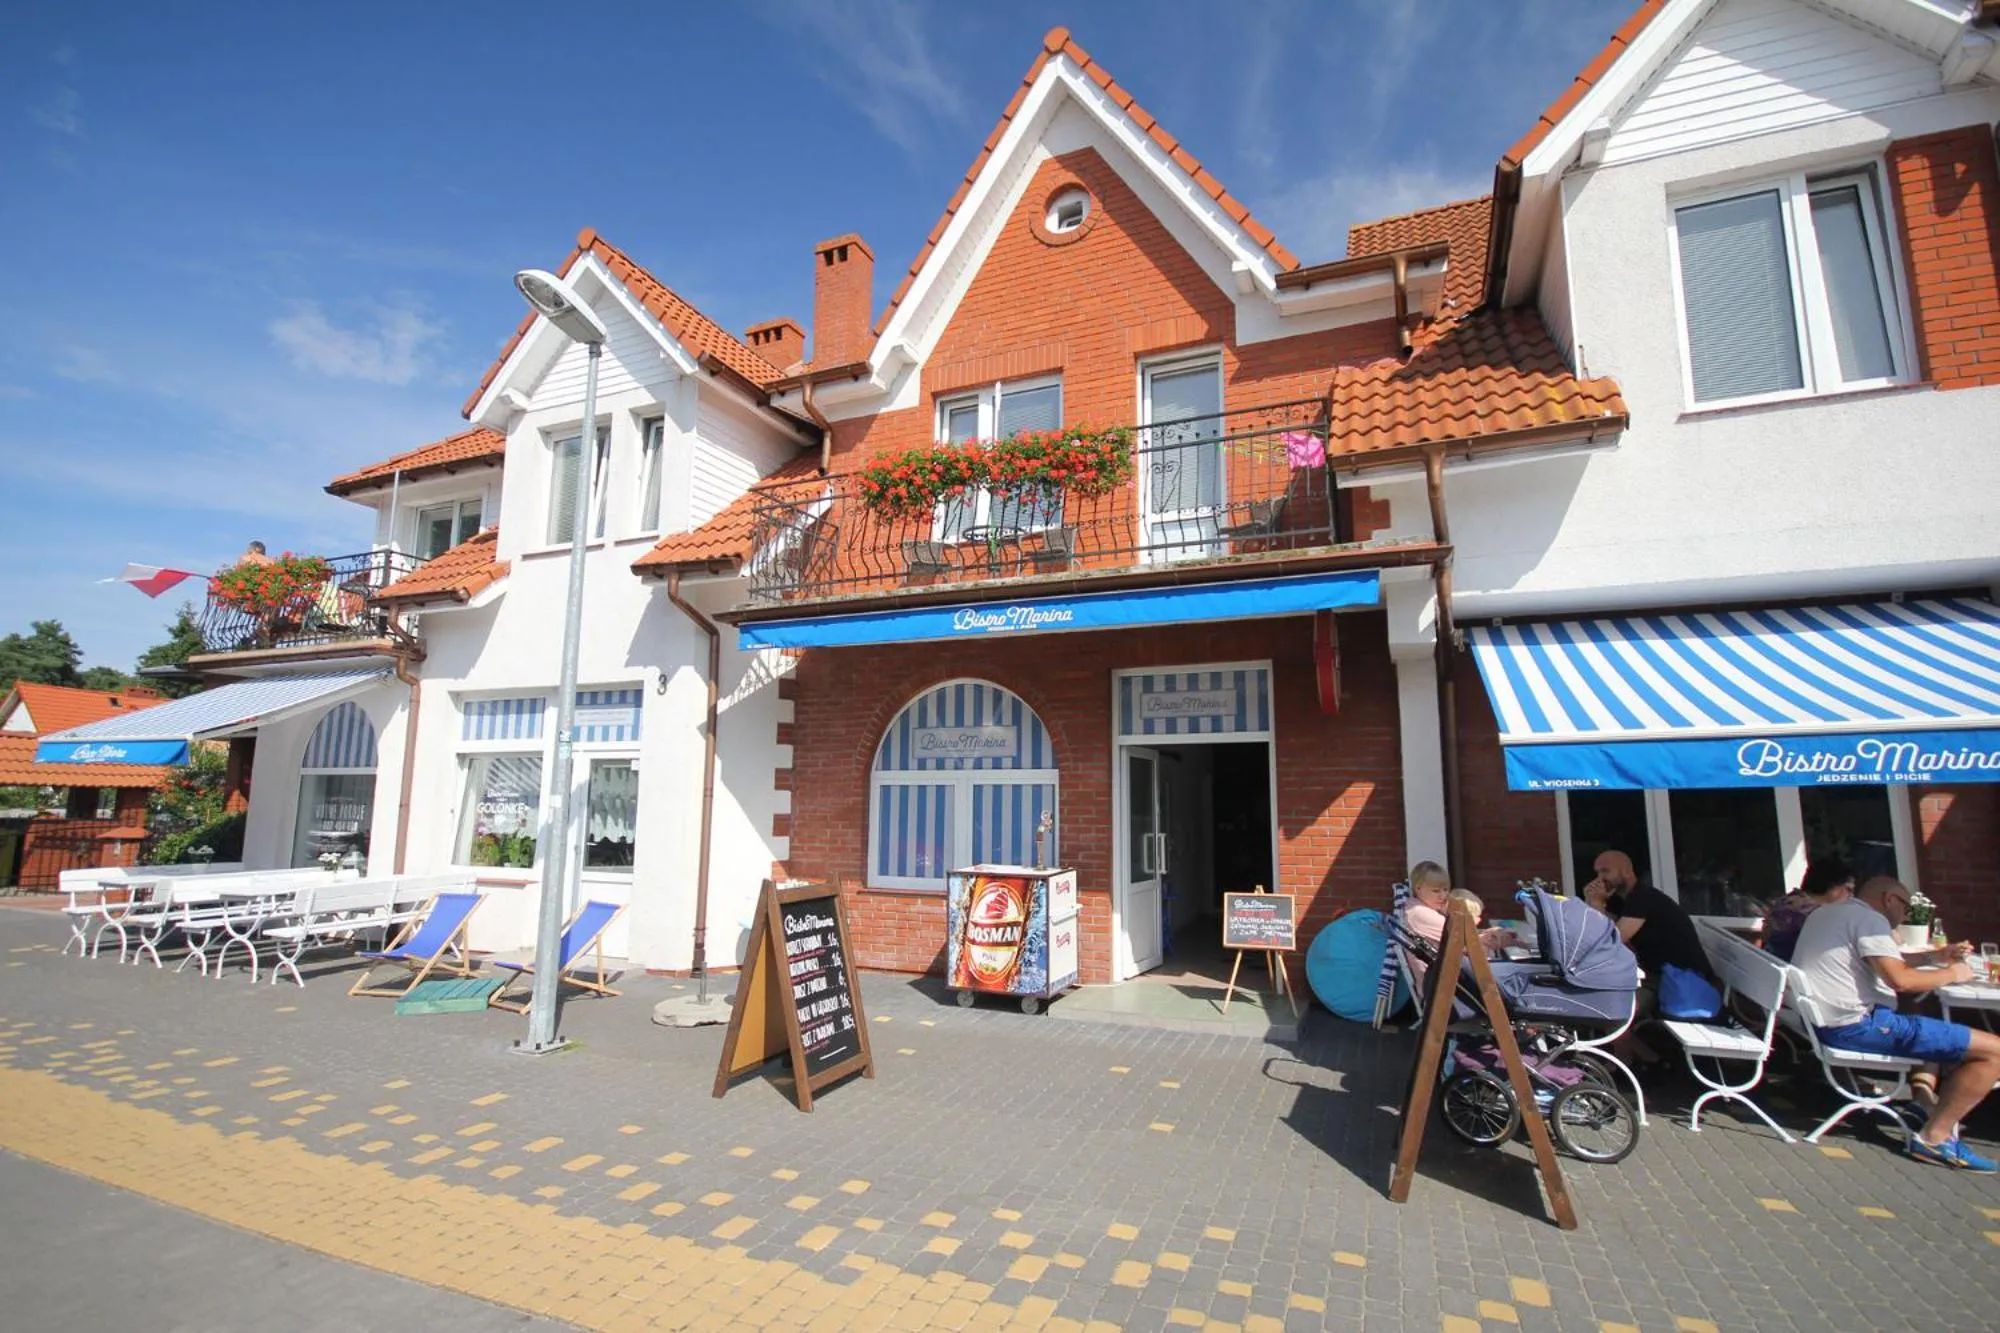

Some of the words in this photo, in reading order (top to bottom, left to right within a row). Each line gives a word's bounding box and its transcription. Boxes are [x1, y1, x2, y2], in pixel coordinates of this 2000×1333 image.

[953, 608, 1007, 630] Bistro
[1006, 606, 1073, 624] Marina
[657, 674, 668, 695] 3
[920, 733, 960, 751] Bistro
[958, 734, 1006, 749] Marina
[1737, 738, 1857, 777] Bistro
[1816, 774, 1882, 782] JEDZENIE
[1895, 773, 1931, 781] PICIE
[967, 923, 1022, 942] BOSMAN
